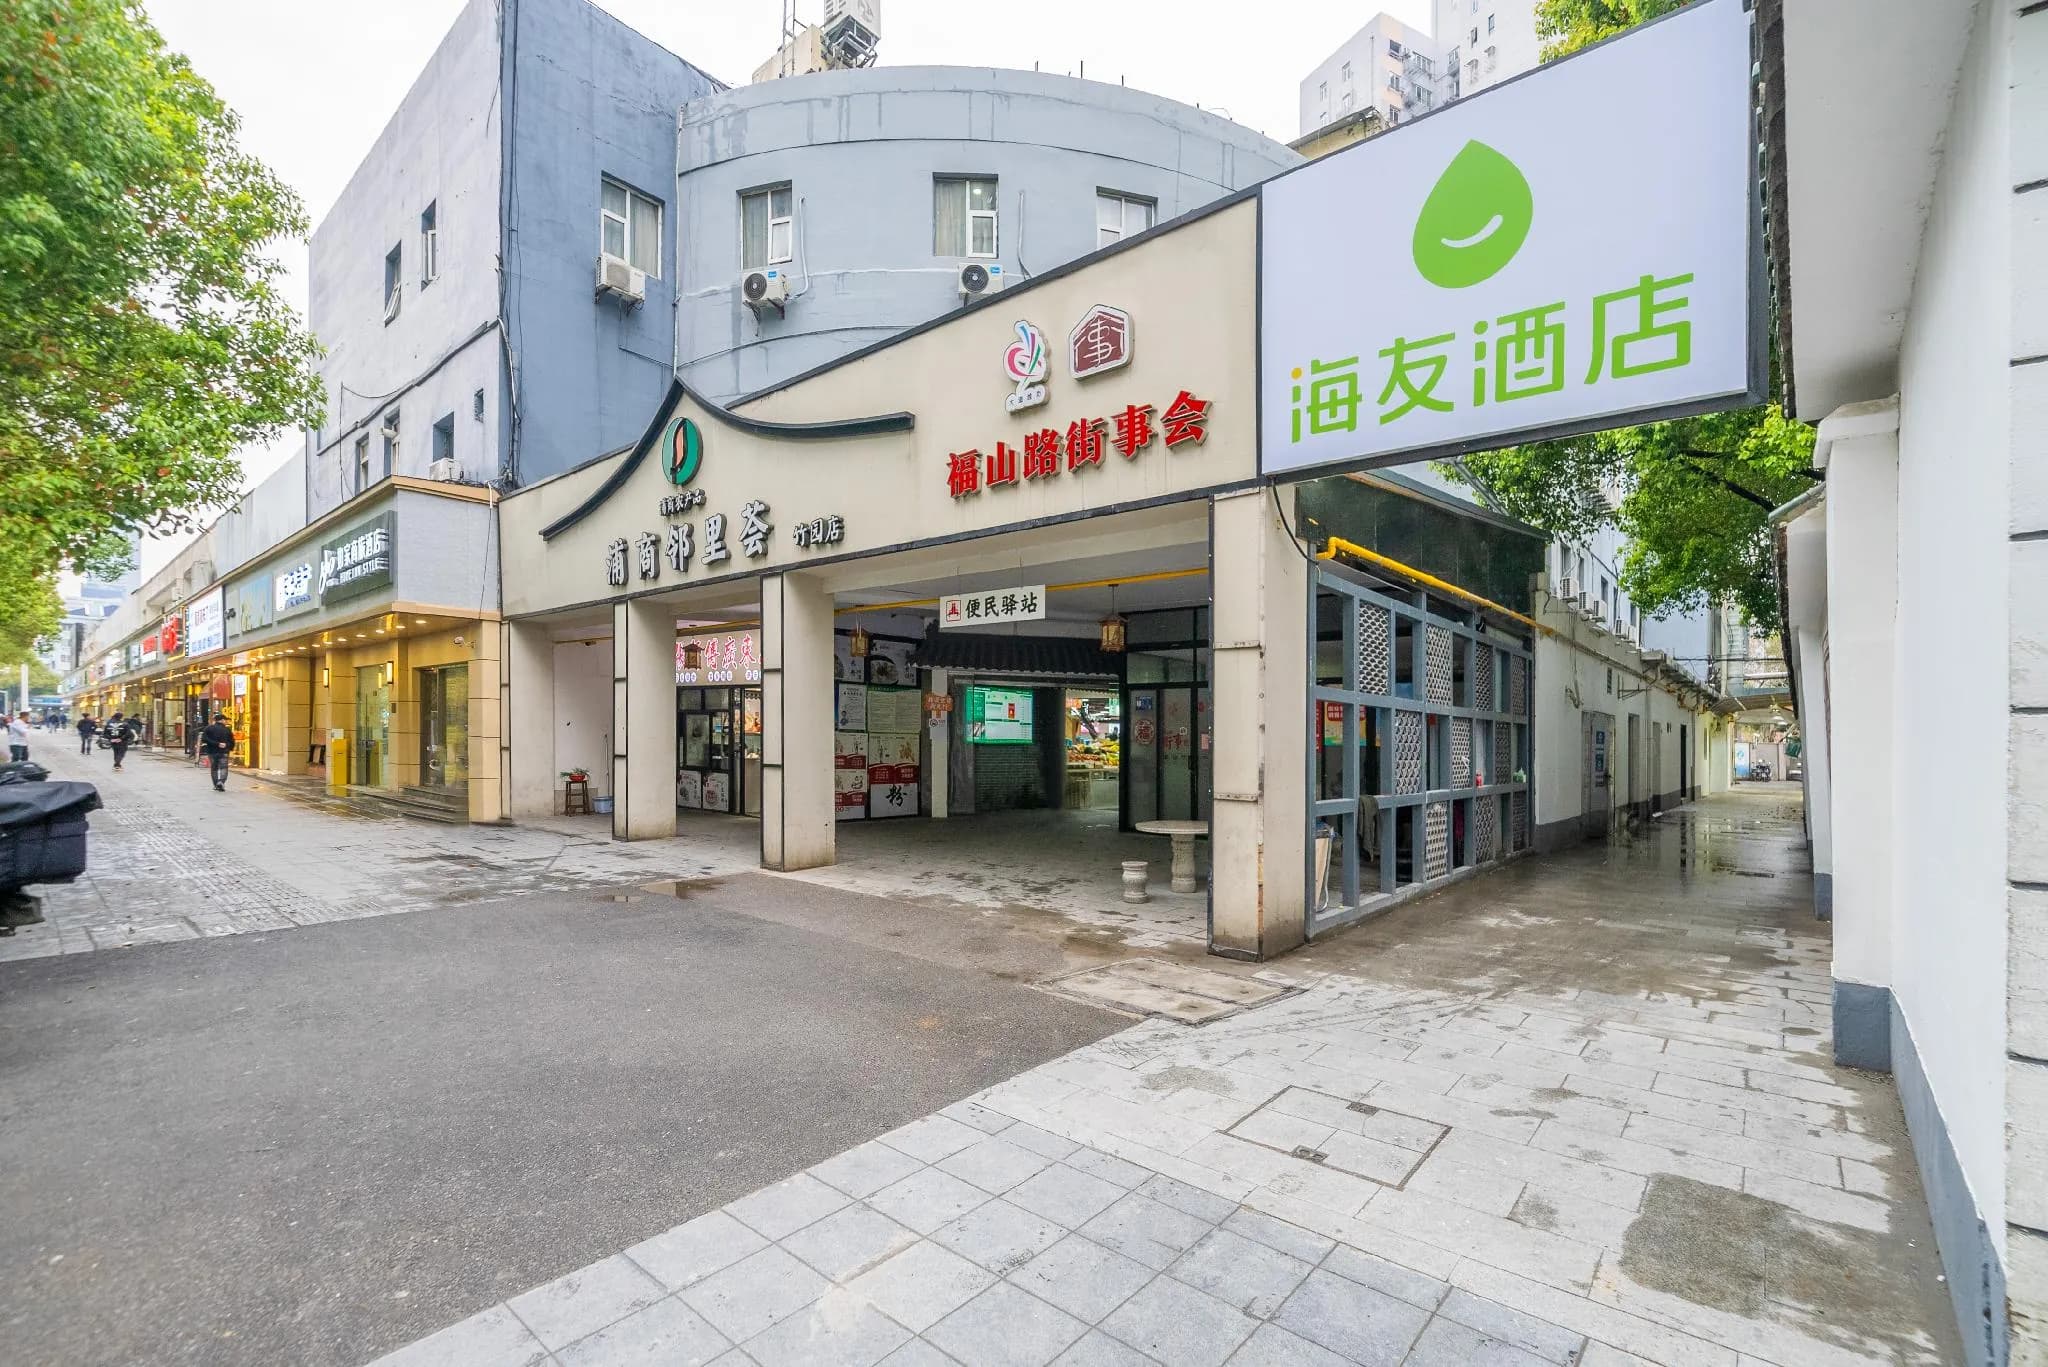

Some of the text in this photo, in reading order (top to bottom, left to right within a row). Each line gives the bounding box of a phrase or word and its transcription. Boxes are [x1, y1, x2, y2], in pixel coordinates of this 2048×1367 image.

[1291, 272, 1694, 443] 海友酒店
[945, 390, 1212, 499] 福山路街事会
[605, 500, 845, 586] 浦商邻里荟 竹园店
[659, 488, 707, 516] 浦商农产品
[965, 592, 1038, 619] 便民驿站
